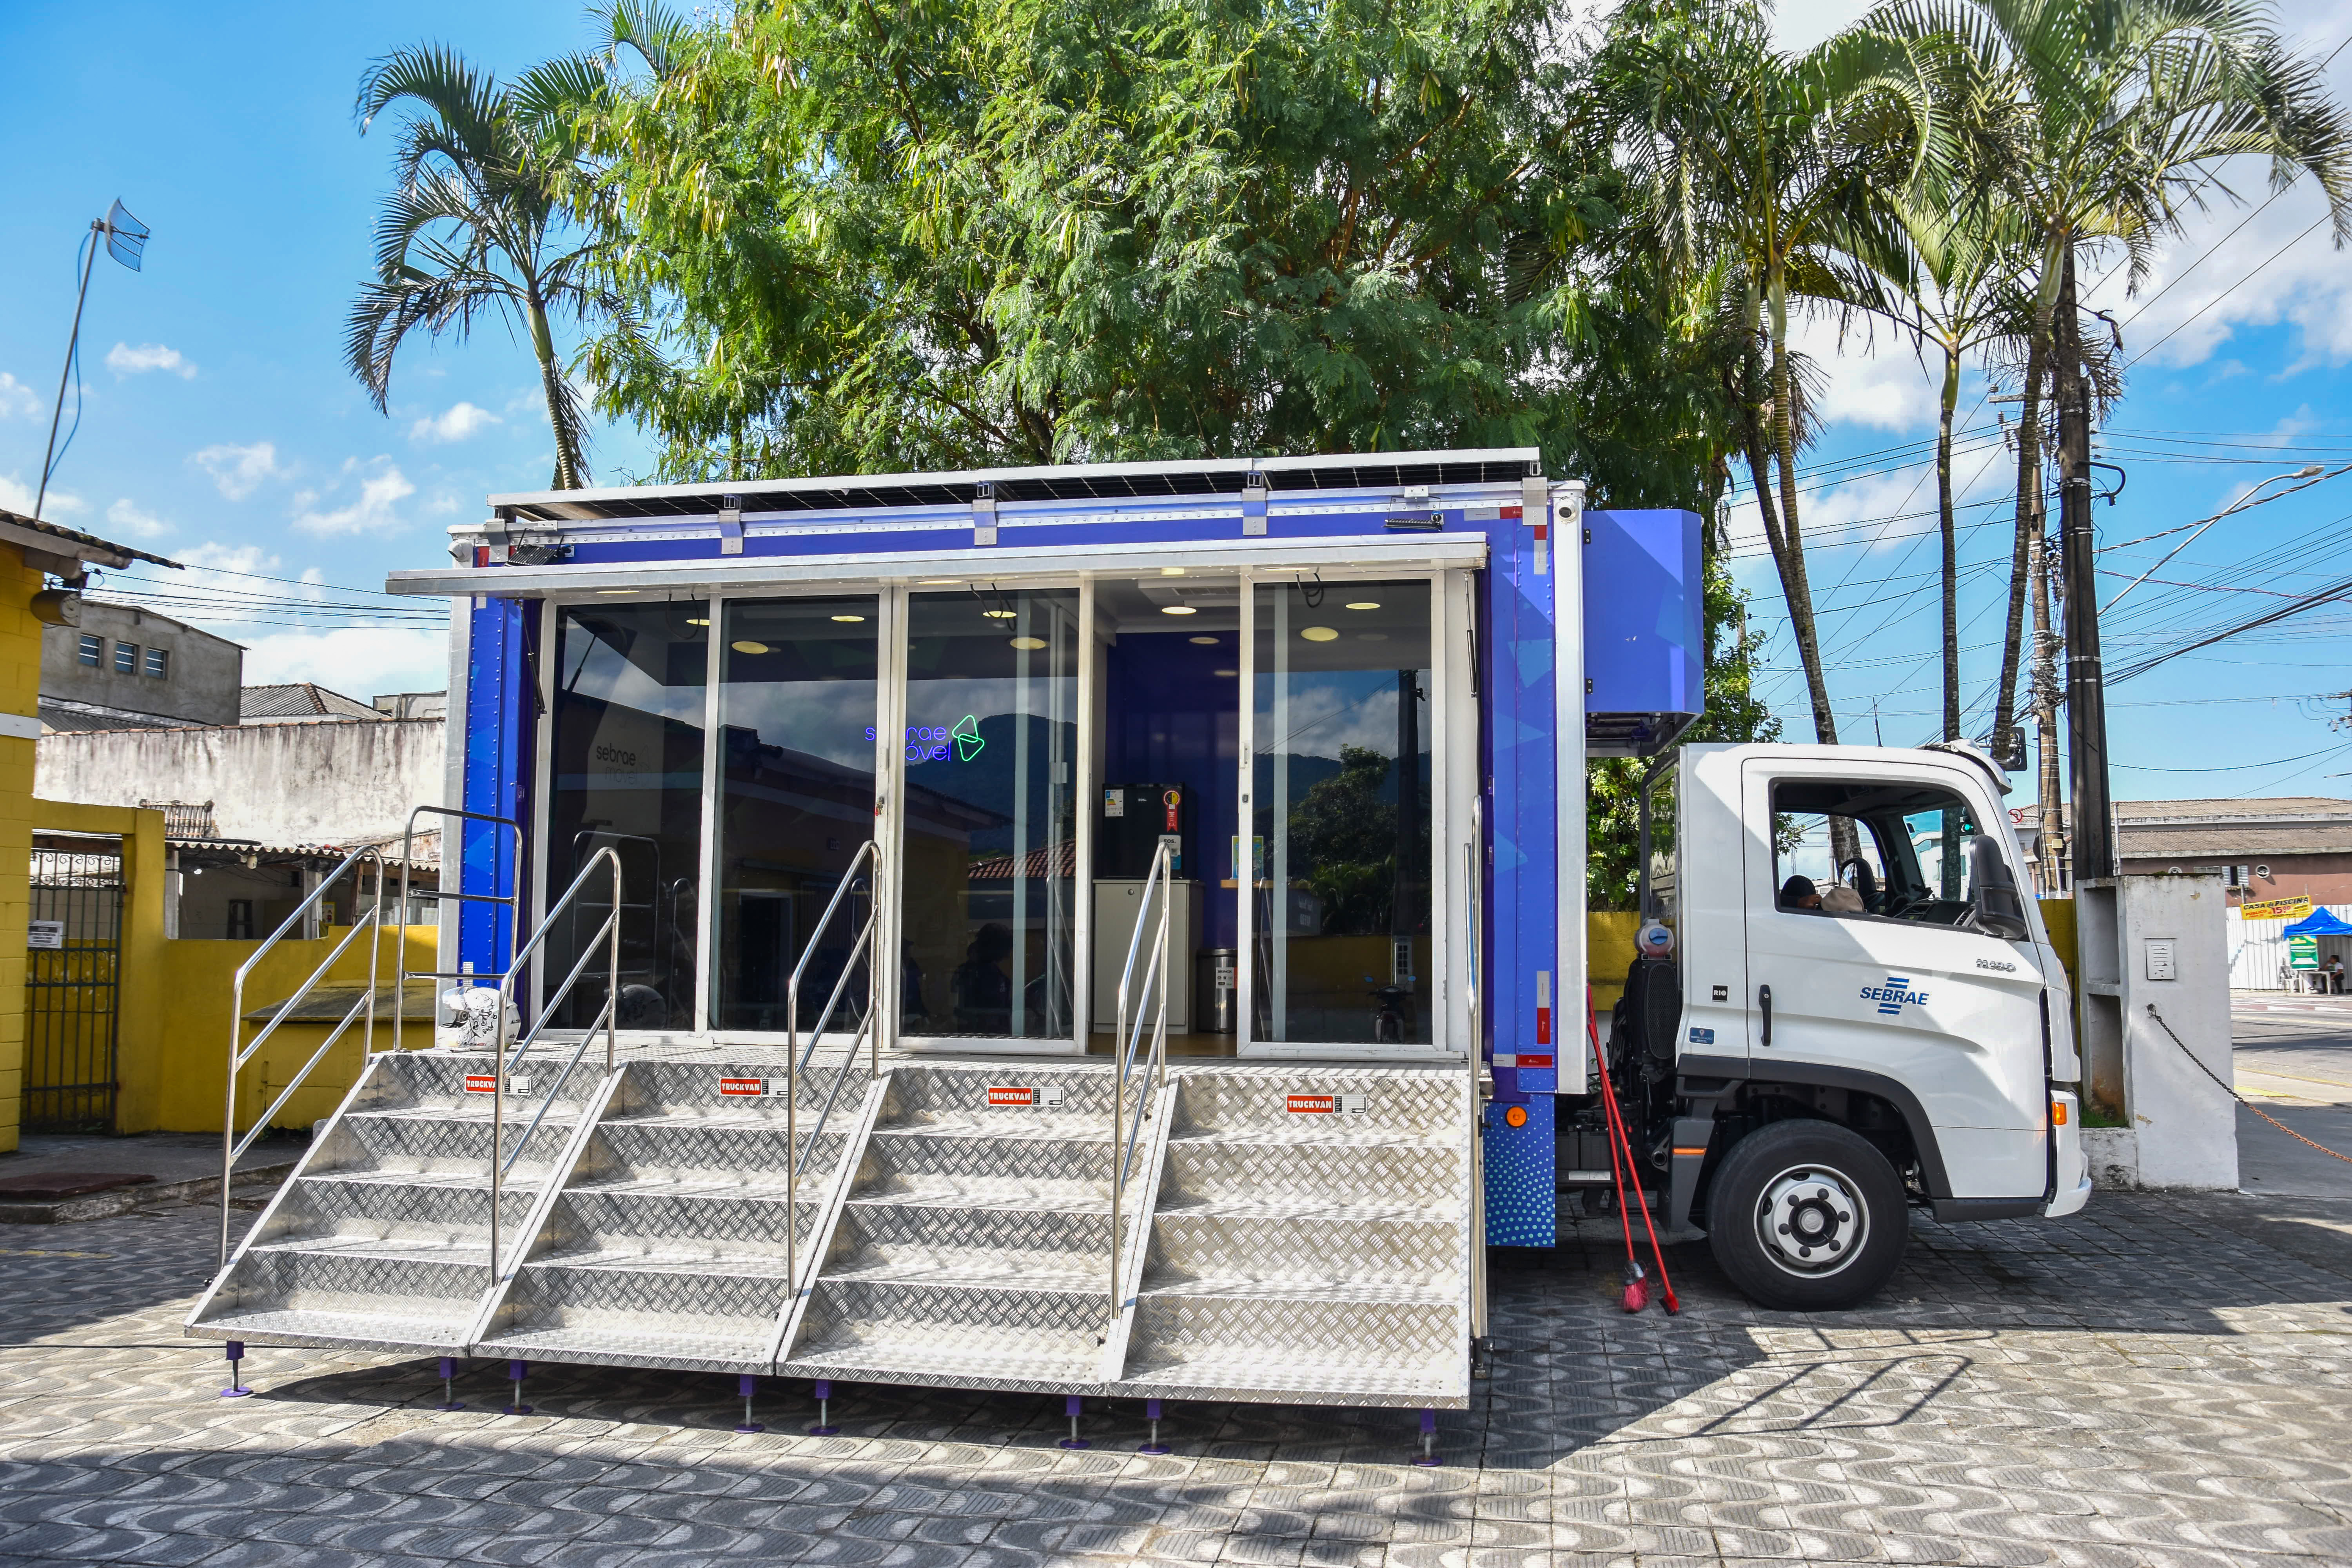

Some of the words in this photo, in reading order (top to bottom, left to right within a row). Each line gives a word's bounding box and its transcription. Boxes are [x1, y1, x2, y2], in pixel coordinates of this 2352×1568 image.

[865, 726, 946, 741] srae
[596, 743, 636, 766] sebrae
[905, 740, 951, 761] óvel
[2275, 897, 2308, 906] PISCINA
[1859, 987, 1930, 1005] SEBRAE
[466, 1080, 496, 1088] TRUCKVA
[1288, 1100, 1332, 1109] TRUCKVAN
